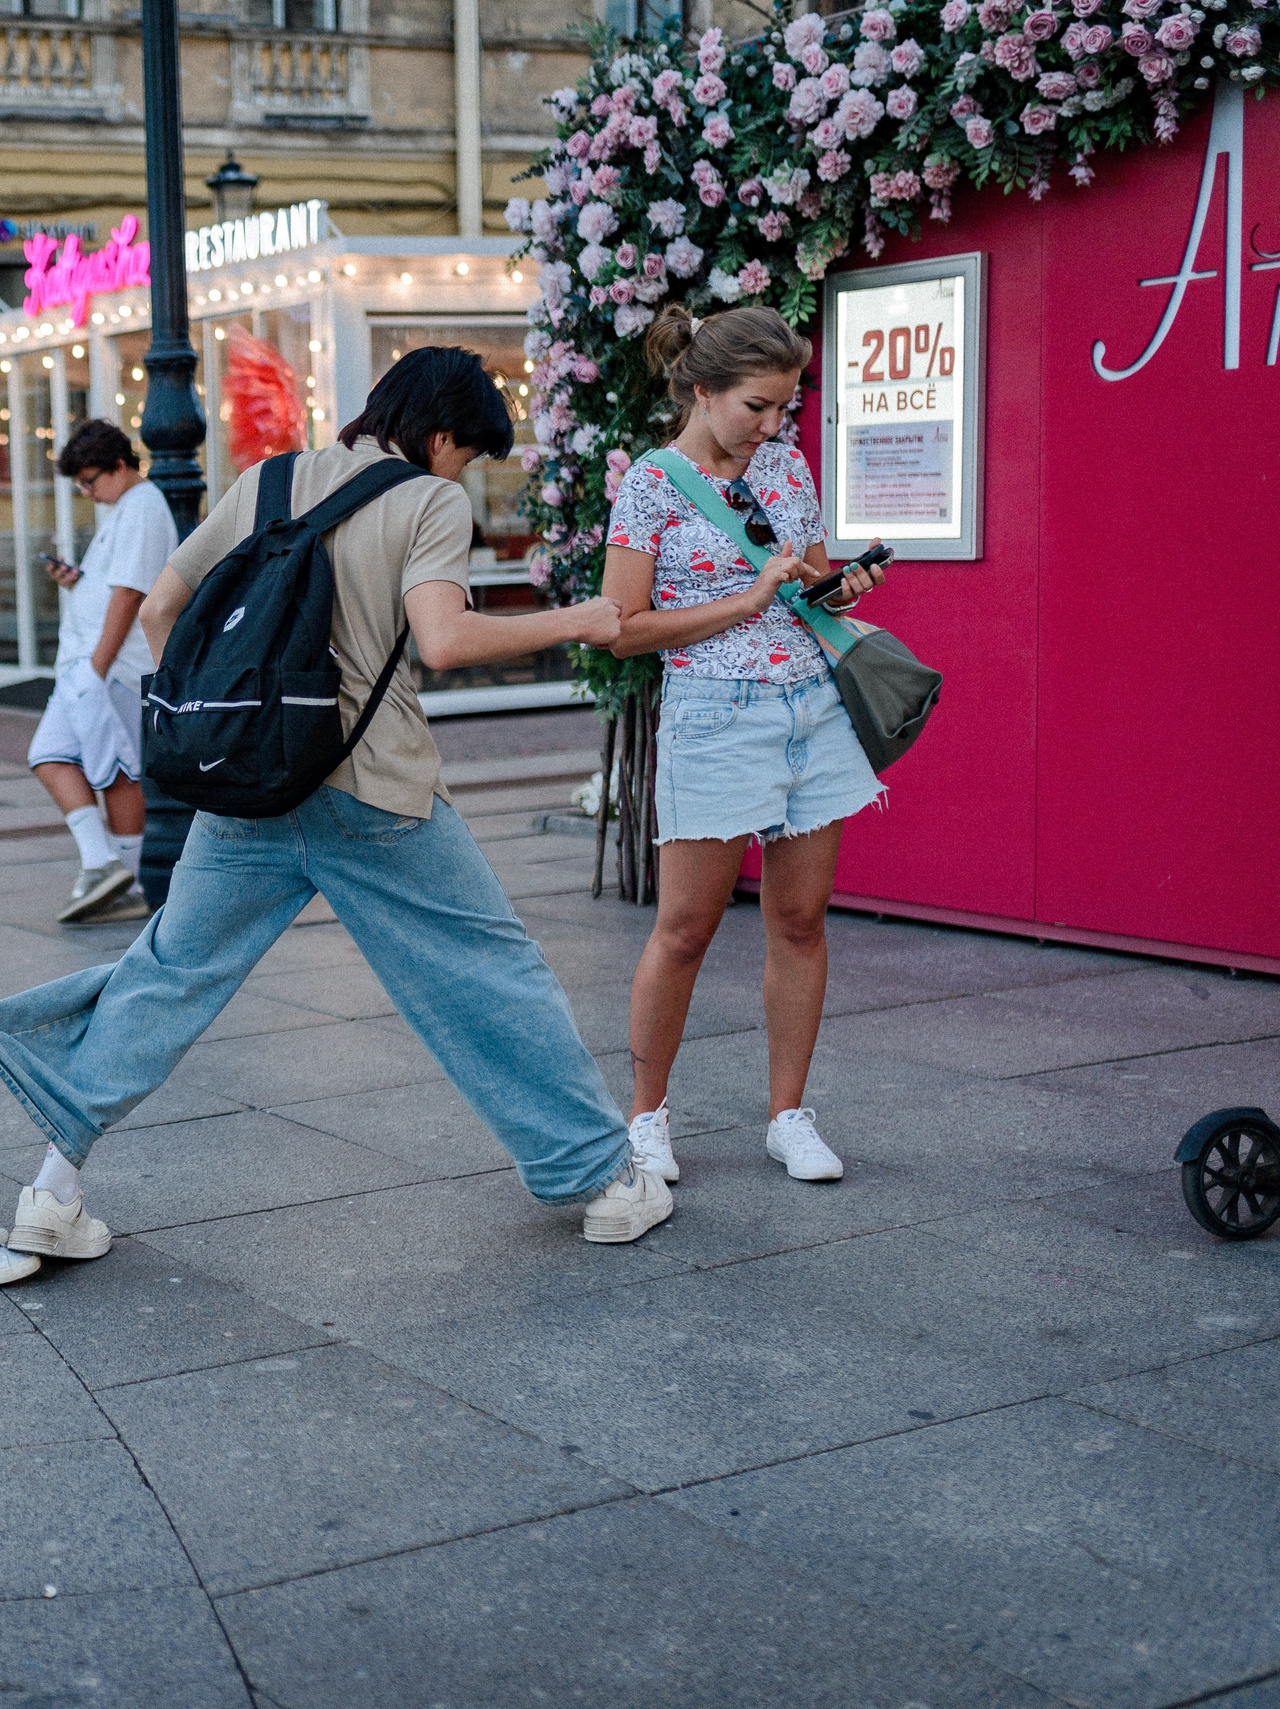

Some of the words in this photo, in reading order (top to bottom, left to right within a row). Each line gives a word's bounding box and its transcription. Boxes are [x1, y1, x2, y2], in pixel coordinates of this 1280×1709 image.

[185, 199, 321, 273] RESTAURANT
[848, 322, 955, 382] -20%
[863, 392, 888, 413] НА
[897, 383, 936, 411] ВСЁ
